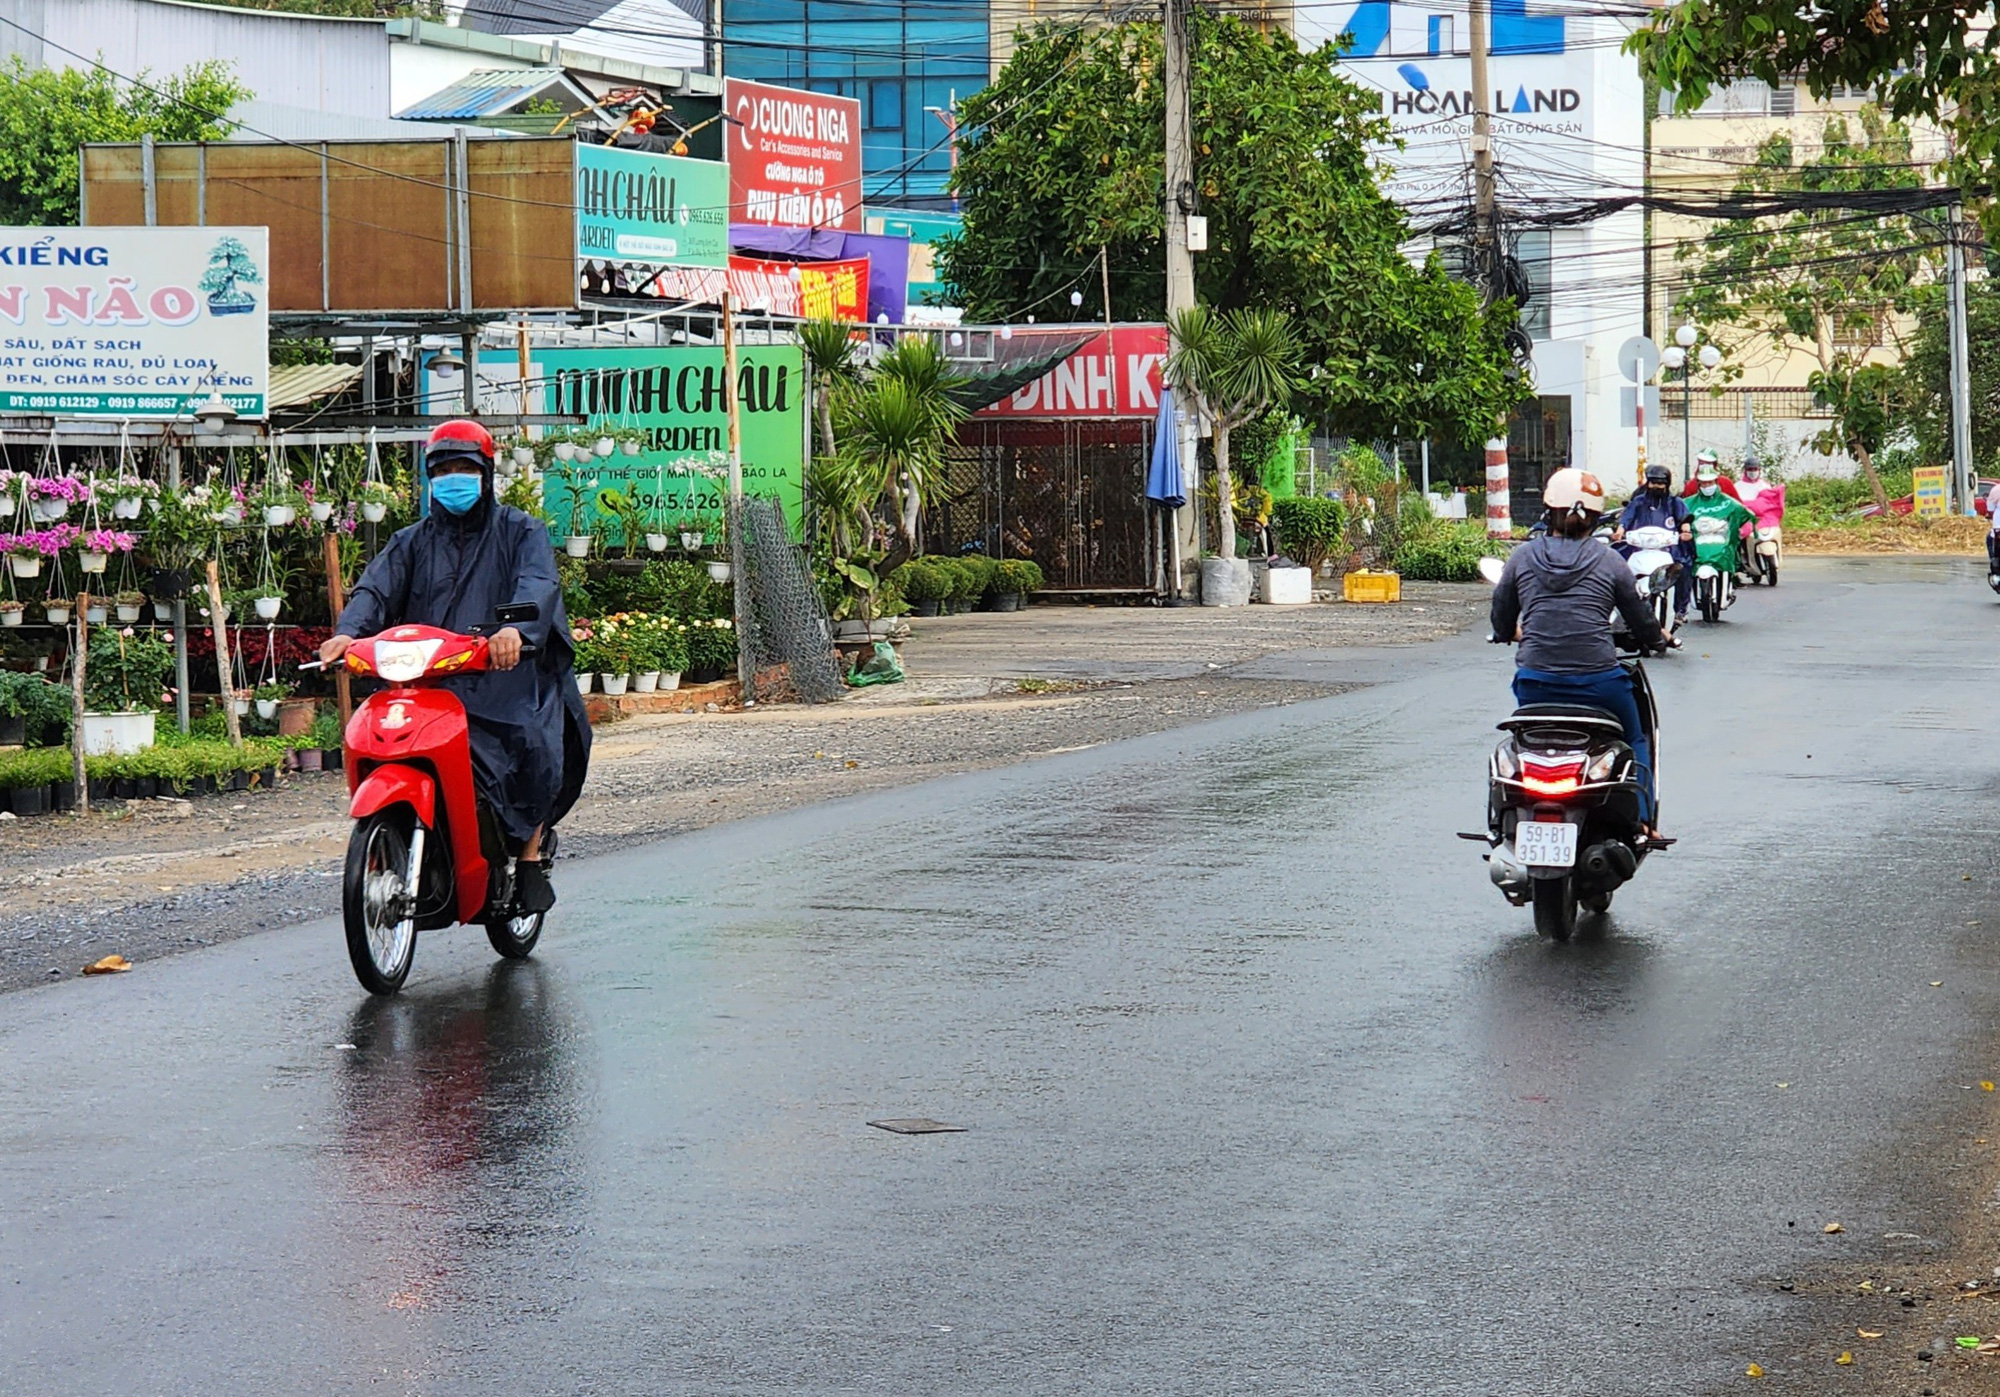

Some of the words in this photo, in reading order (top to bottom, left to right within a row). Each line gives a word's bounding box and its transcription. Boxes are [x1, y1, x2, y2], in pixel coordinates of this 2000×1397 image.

[1496, 83, 1581, 113] LAND
[759, 97, 815, 141] CUONG
[817, 106, 849, 145] NGA
[1557, 120, 1583, 133] SẢN
[777, 140, 811, 158] Accessories
[811, 146, 822, 159] and
[822, 146, 843, 162] Service
[612, 165, 677, 226] CHÂU
[747, 188, 777, 228] PHỤ
[778, 186, 811, 229] KIỆN
[811, 190, 824, 226] Ô
[825, 191, 844, 229] TÔ
[43, 276, 198, 322] NÃO
[52, 336, 87, 350] ĐẤT
[94, 340, 141, 352] SẠCH
[0, 356, 25, 369] ẠT
[33, 354, 86, 368] GIỐNG
[93, 358, 134, 370] RAU,
[141, 354, 165, 369] ĐỦ
[113, 373, 149, 386] SÓC
[155, 373, 190, 386] CÂY
[676, 356, 791, 415] CHÂU
[29, 396, 57, 408] 0919
[59, 397, 99, 408] 612129
[107, 397, 135, 409] 0919
[137, 397, 178, 409] 866657
[608, 464, 631, 480] THẾ
[742, 467, 766, 478] BAO
[773, 468, 787, 478] LA
[1526, 825, 1566, 844] 59-B1
[1520, 844, 1571, 862] 351.39
